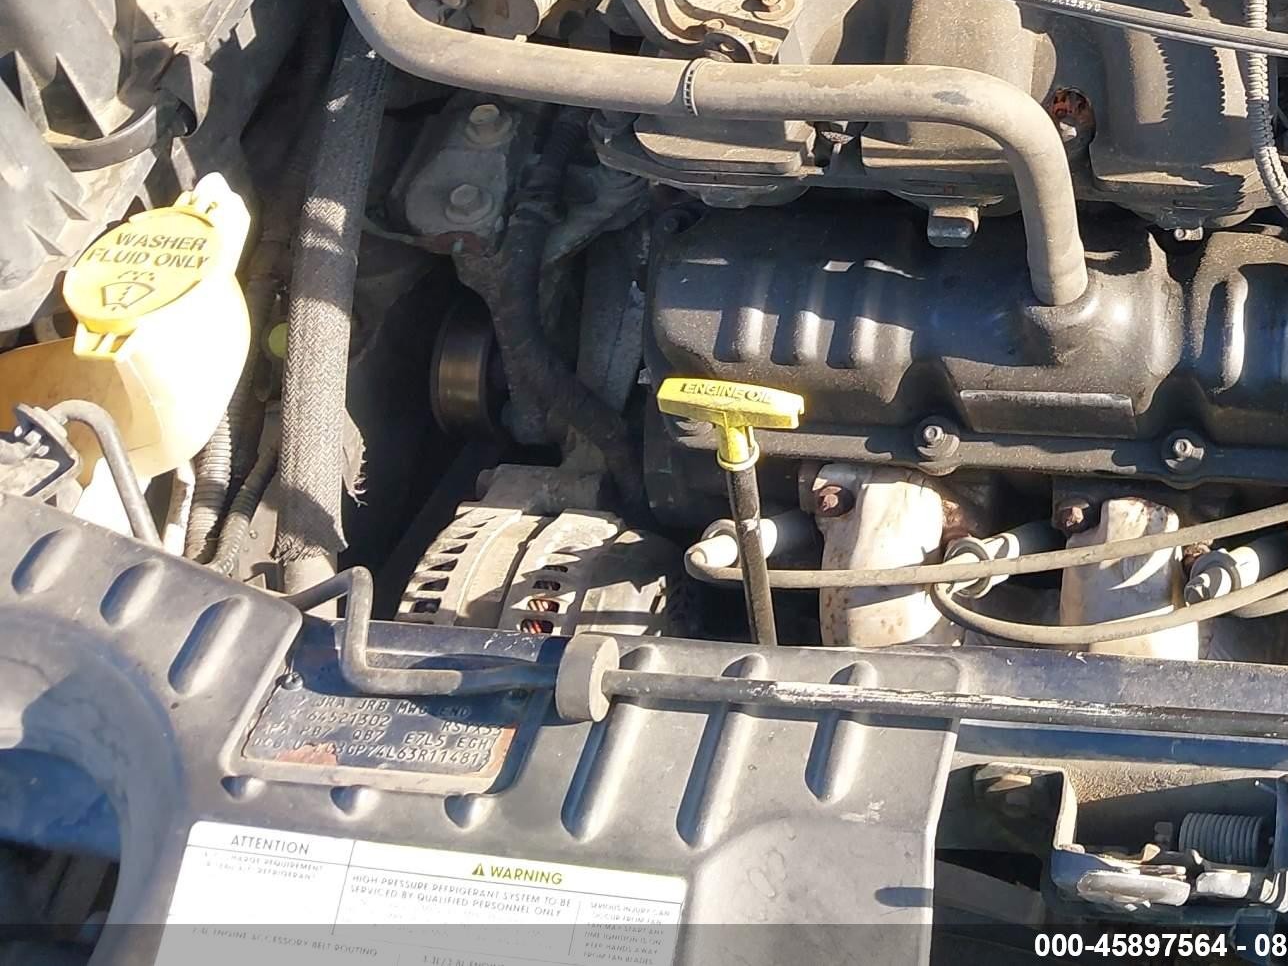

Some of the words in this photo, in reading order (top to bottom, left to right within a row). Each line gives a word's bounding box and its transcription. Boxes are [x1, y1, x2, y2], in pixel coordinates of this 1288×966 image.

[115, 233, 208, 251] WASHER
[86, 248, 150, 265] FLUID
[153, 252, 210, 270] ONLY
[680, 382, 742, 400] ENGINE
[358, 699, 390, 711] JRB
[230, 834, 310, 855] ATTENTION
[489, 865, 563, 885] WARNING
[351, 885, 398, 898] SERVICED
[401, 890, 414, 900] BY
[417, 892, 468, 907] QUALIFIED
[472, 899, 530, 915] PERSONNEL
[534, 907, 562, 917] ONLY
[352, 875, 379, 884] HIGH
[381, 877, 430, 892] PRESSURE
[432, 883, 499, 900] REFRIGERANT
[502, 892, 541, 904] SYSTEM
[545, 896, 557, 906] TO
[560, 898, 571, 908] BE
